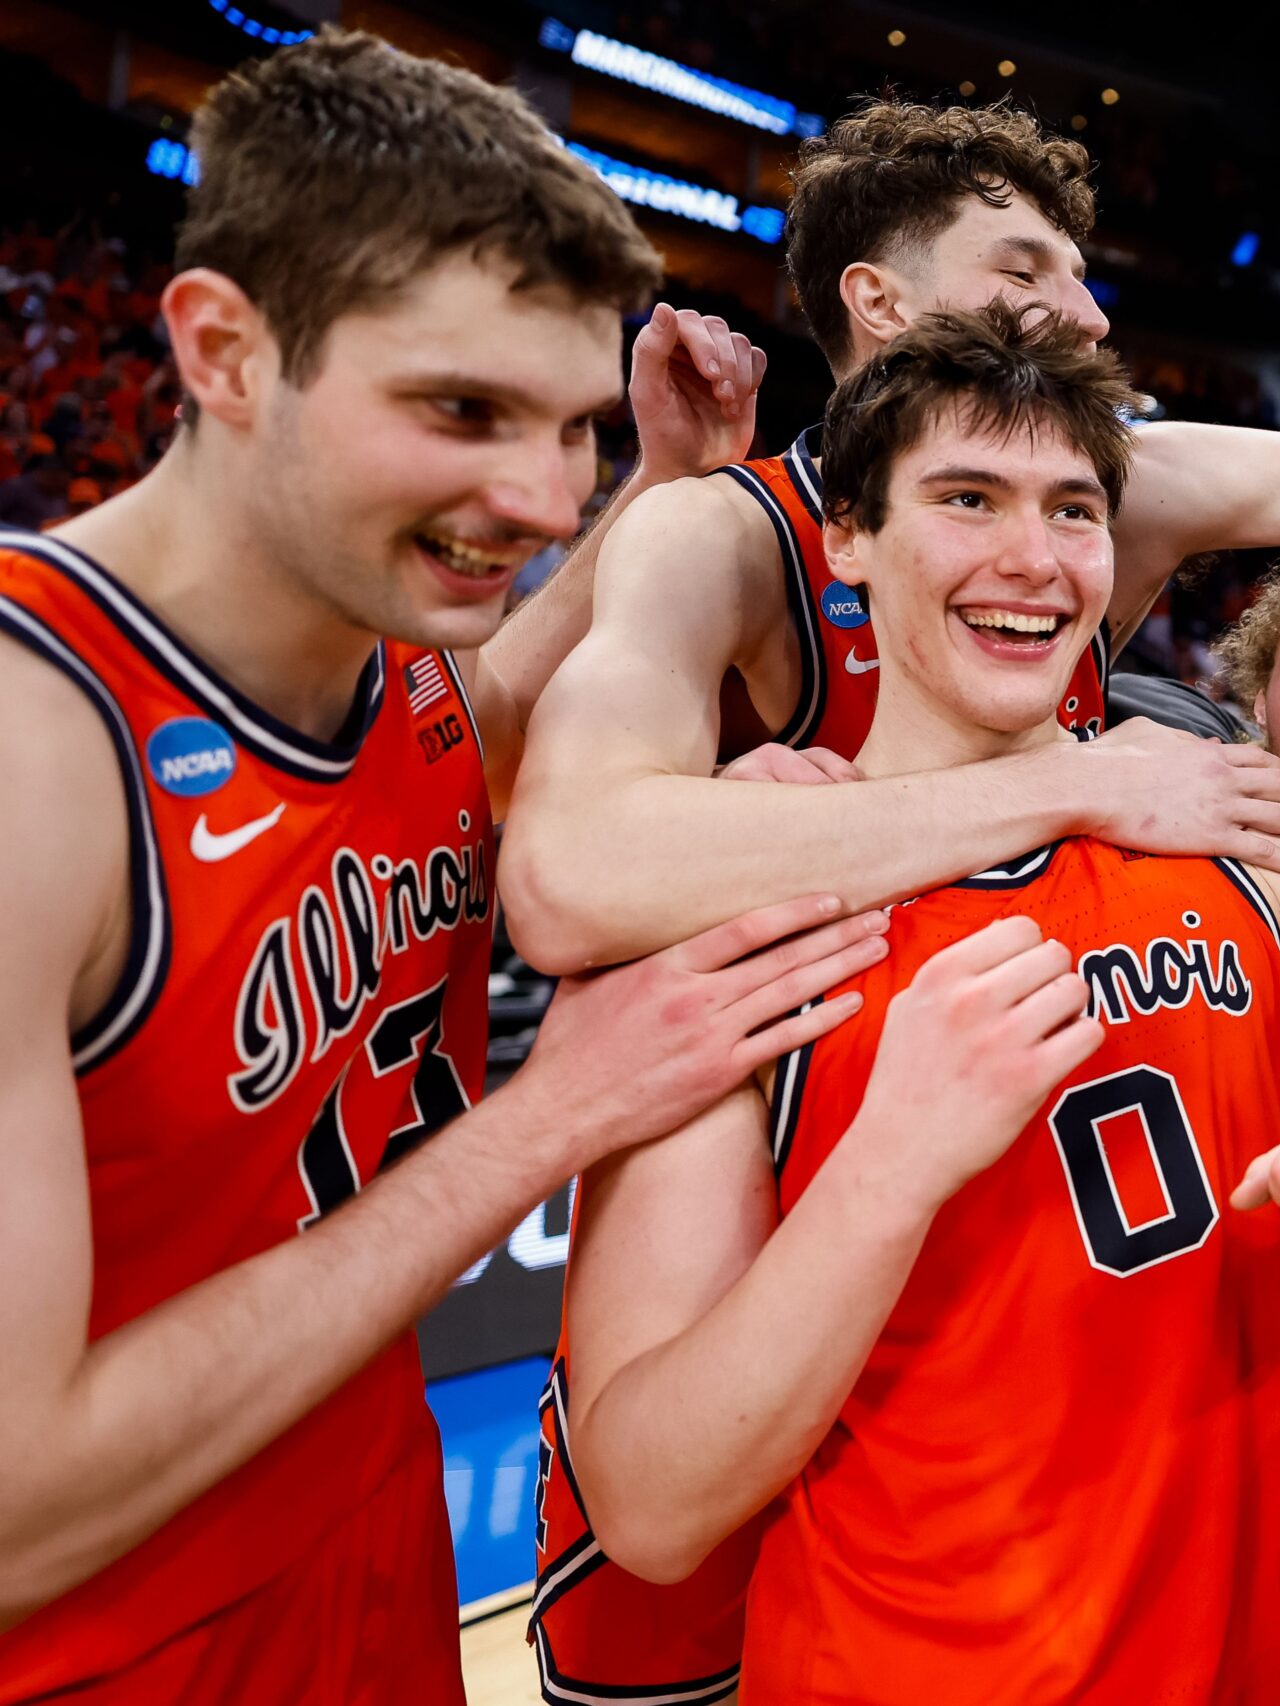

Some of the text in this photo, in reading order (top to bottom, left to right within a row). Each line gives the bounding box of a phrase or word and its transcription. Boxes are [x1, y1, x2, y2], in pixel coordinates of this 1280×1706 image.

[829, 602, 863, 616] NCA
[160, 747, 233, 784] NCAA
[1077, 910, 1252, 1025] nois
[1047, 1063, 1220, 1278] 0
